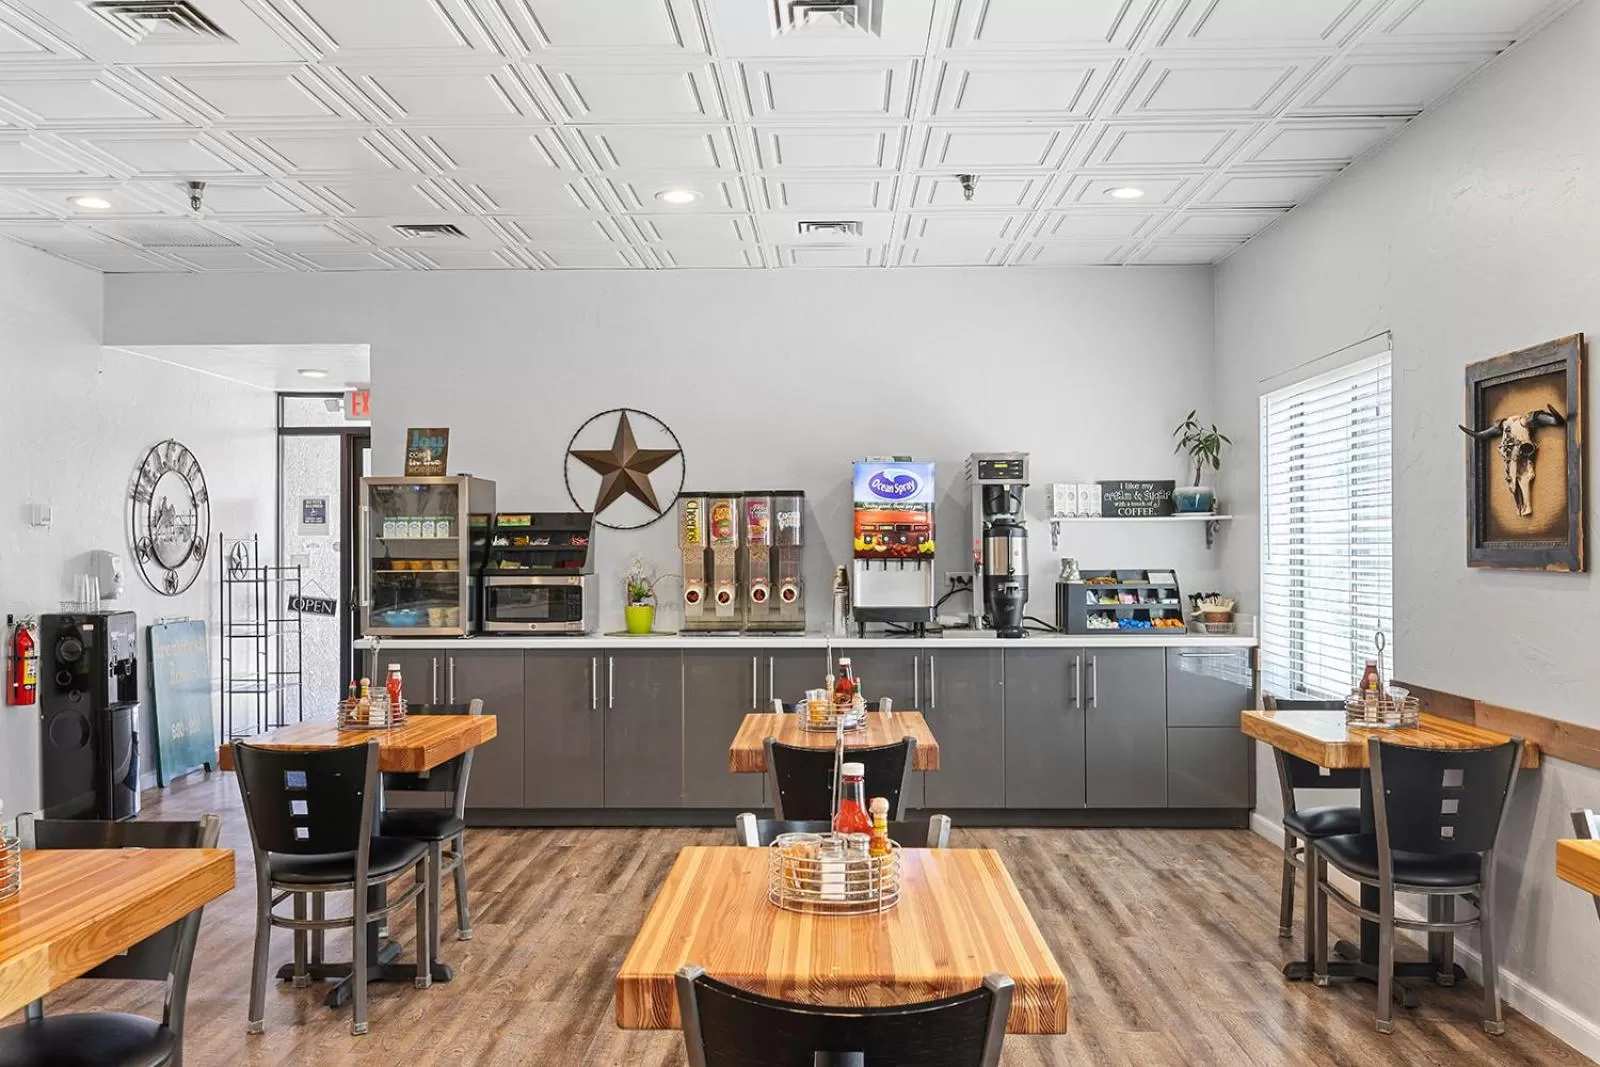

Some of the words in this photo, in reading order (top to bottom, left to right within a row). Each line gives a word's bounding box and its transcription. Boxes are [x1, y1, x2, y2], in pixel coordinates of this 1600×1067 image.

[872, 478, 894, 494] Ocean
[894, 480, 915, 496] Spray
[1125, 482, 1140, 490] like
[1142, 483, 1154, 491] my
[1134, 491, 1143, 501] &
[686, 500, 699, 543] Cheerios
[292, 598, 333, 613] OPEN
